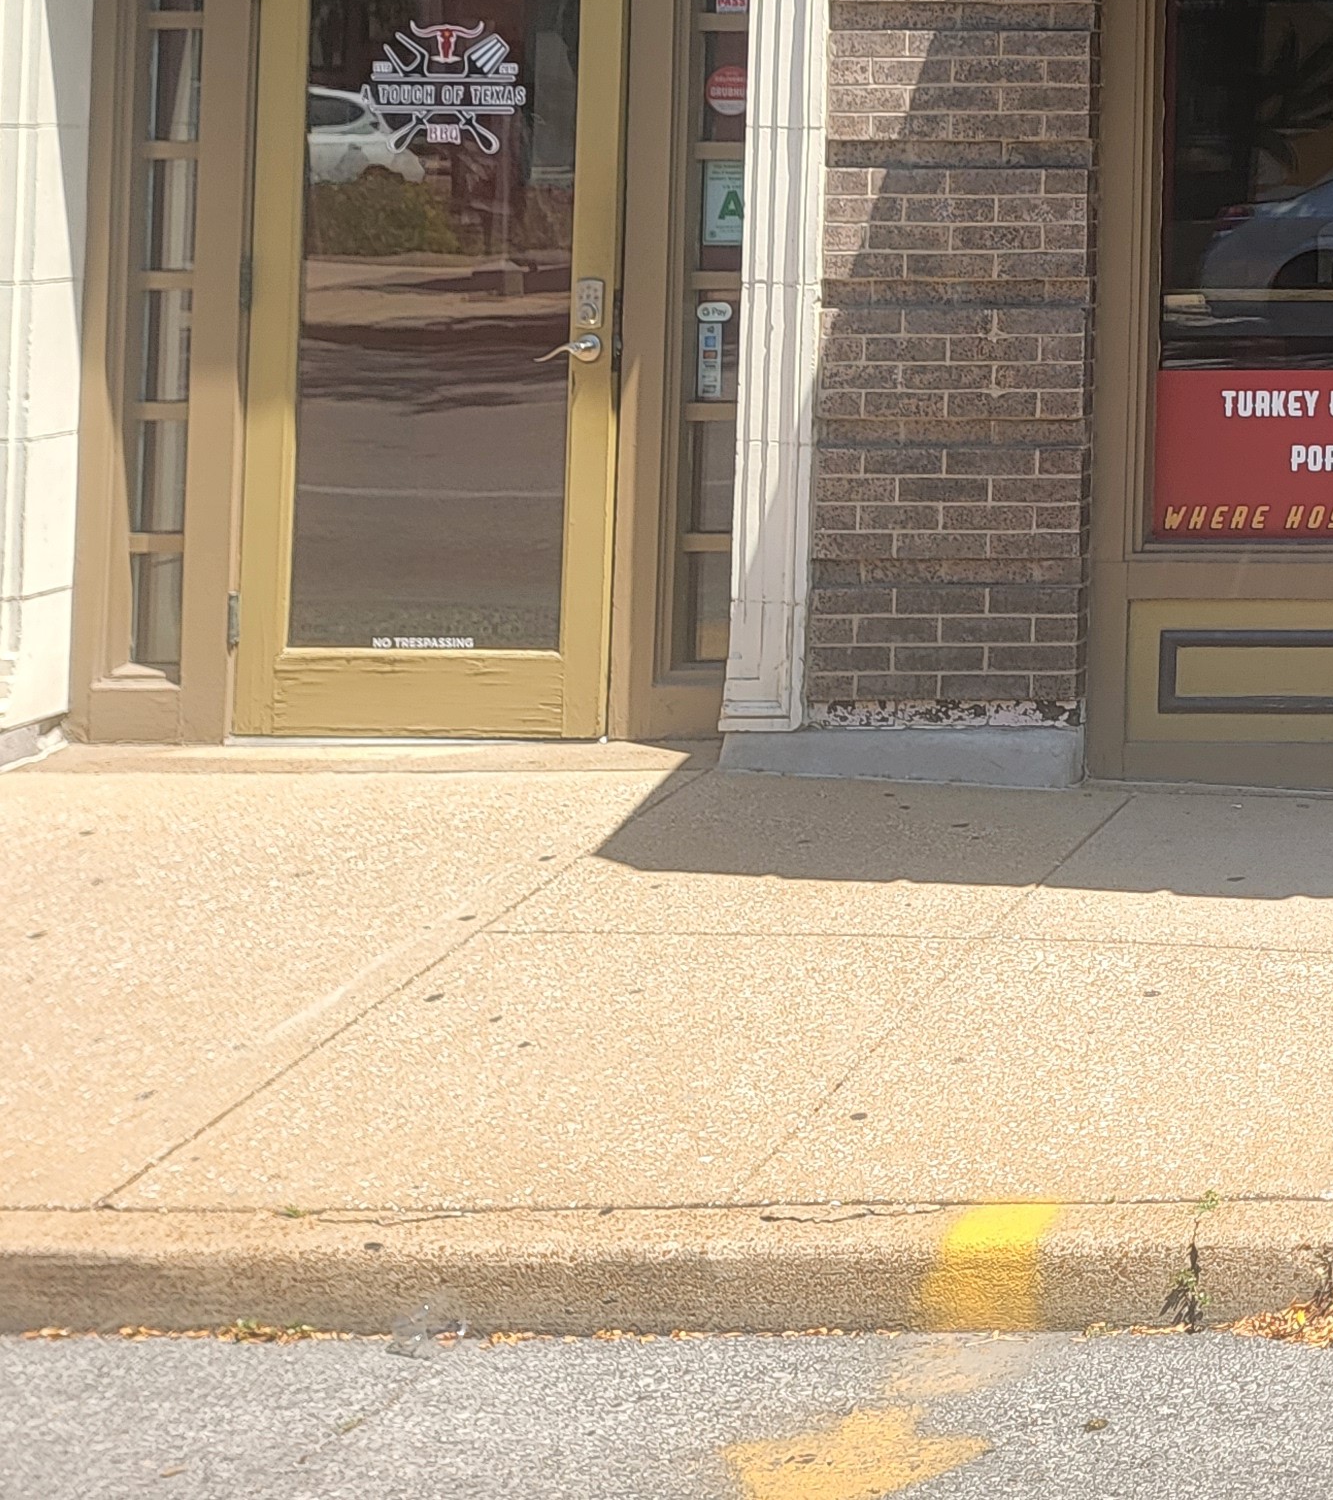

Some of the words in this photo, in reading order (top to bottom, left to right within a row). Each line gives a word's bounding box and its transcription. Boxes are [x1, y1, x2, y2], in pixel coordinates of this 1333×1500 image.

[378, 85, 435, 106] TOUCH
[442, 85, 465, 106] OF
[470, 86, 526, 106] TEXAS
[710, 86, 745, 98] GRUBHU
[718, 190, 744, 220] A
[1222, 391, 1319, 416] TURKEY
[1165, 506, 1269, 529] WHERE
[372, 637, 392, 649] NO
[394, 638, 474, 648] TRESPASSING
